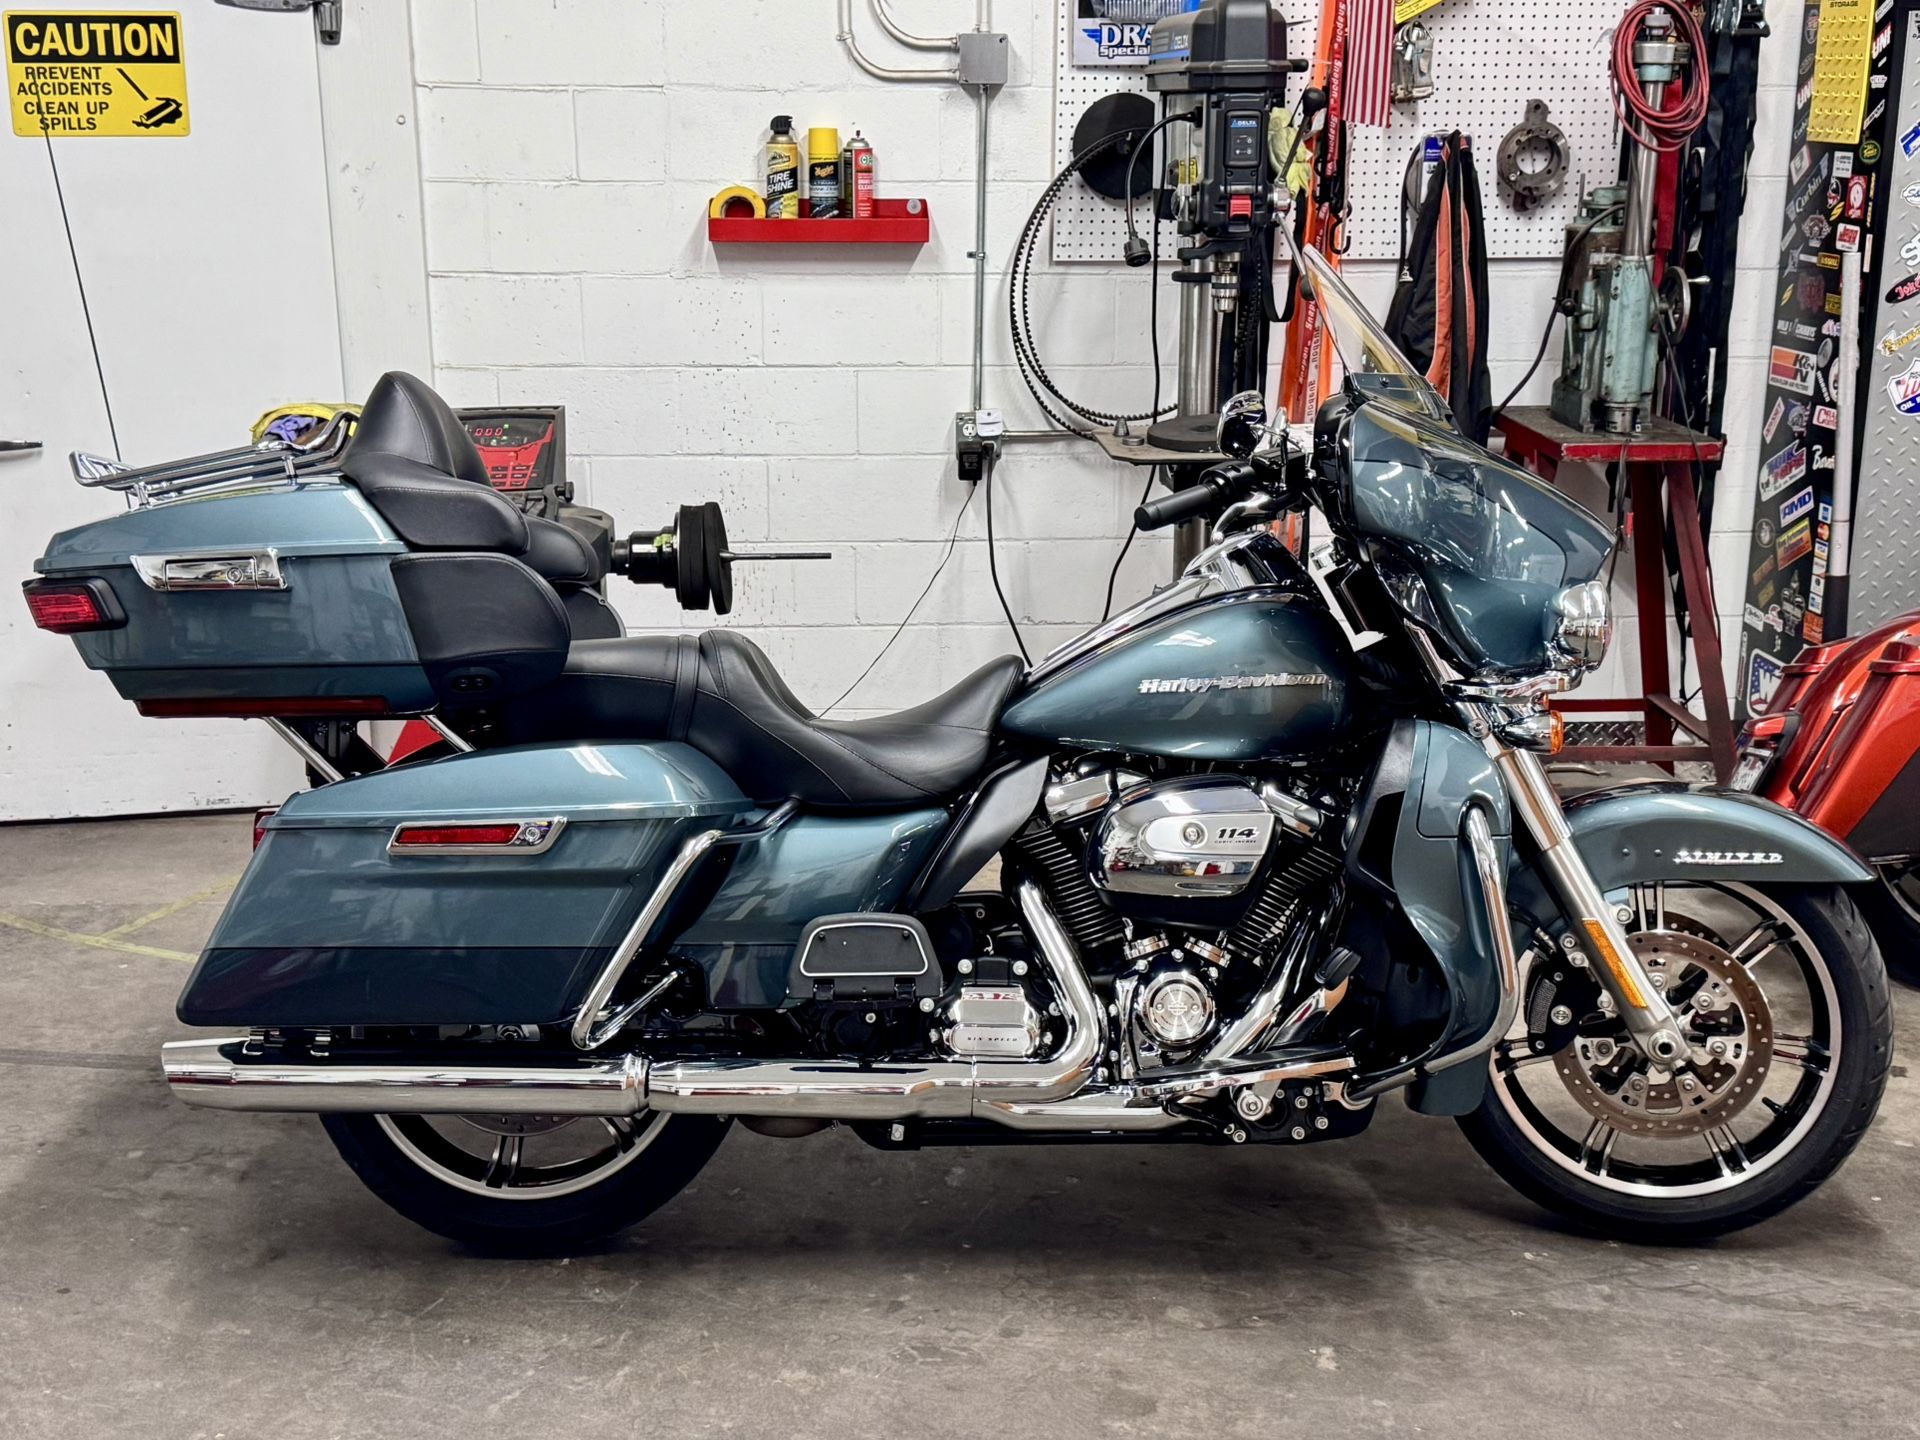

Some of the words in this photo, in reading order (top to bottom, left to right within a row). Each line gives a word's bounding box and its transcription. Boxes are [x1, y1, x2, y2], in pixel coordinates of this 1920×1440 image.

[15, 22, 174, 57] CAUTION
[1099, 23, 1152, 46] DRA
[1099, 46, 1151, 58] Special
[25, 66, 102, 80] PREVENT
[17, 82, 113, 96] ACCIDENTS
[24, 101, 80, 115] CLEAN
[87, 101, 110, 115] UP
[40, 117, 97, 131] SPILLS
[770, 171, 790, 184] TIRE
[767, 179, 794, 194] SHINE
[1137, 672, 1329, 694] Harley-Davidson
[1217, 828, 1256, 839] 114
[1676, 849, 1783, 865] LIMITED
